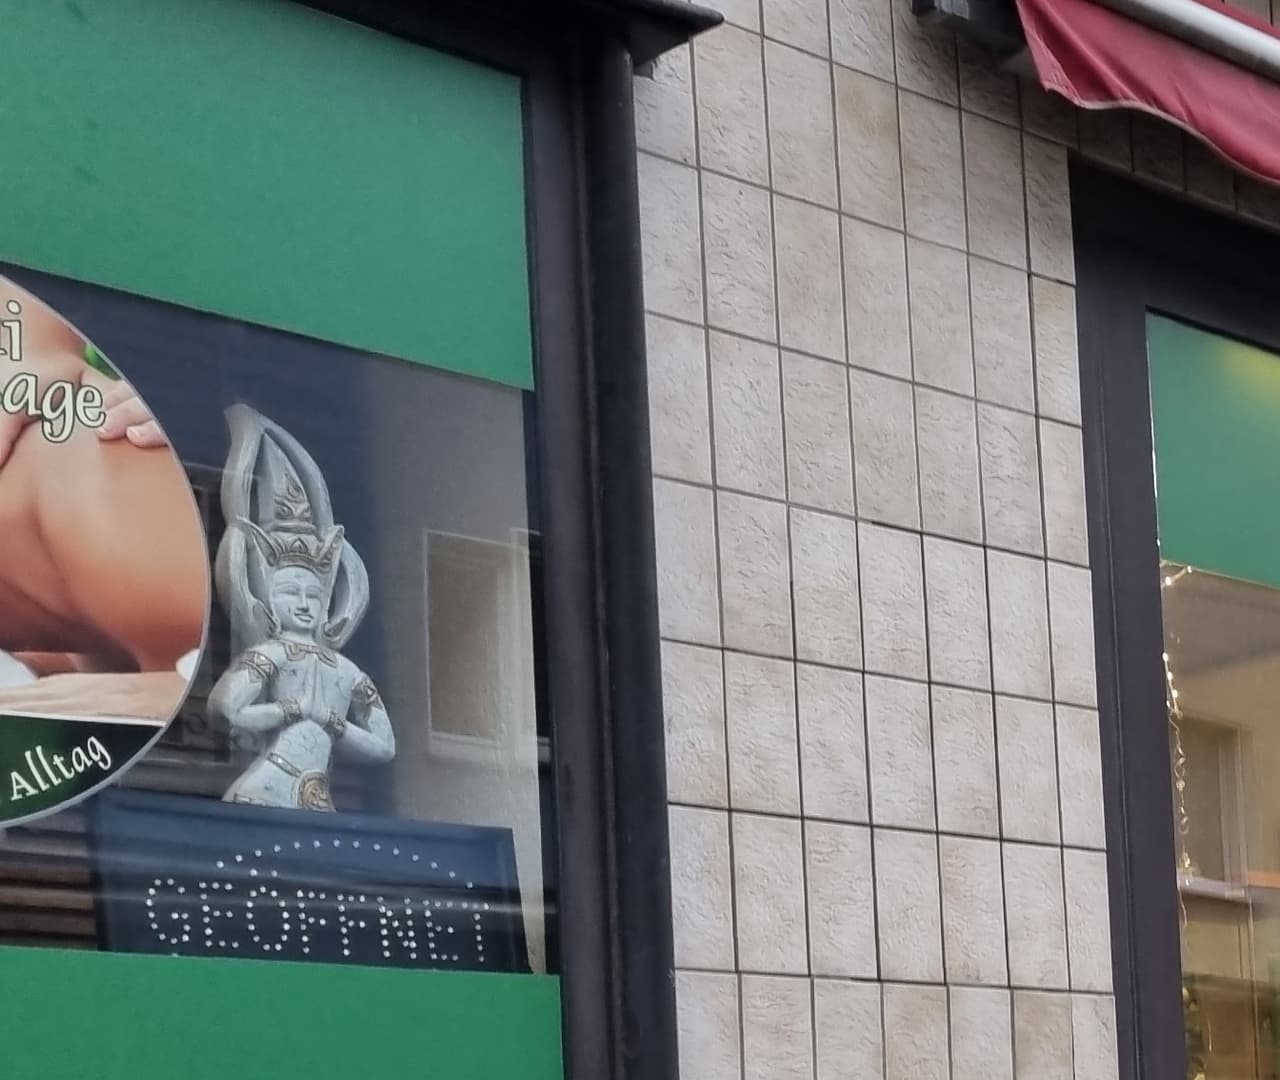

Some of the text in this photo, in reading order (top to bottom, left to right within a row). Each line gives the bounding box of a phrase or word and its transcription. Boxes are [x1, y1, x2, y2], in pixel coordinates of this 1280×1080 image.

[0, 299, 22, 361] i
[0, 372, 106, 443] age
[10, 736, 112, 801] Alltag
[145, 867, 492, 963] GEÖFFNET
